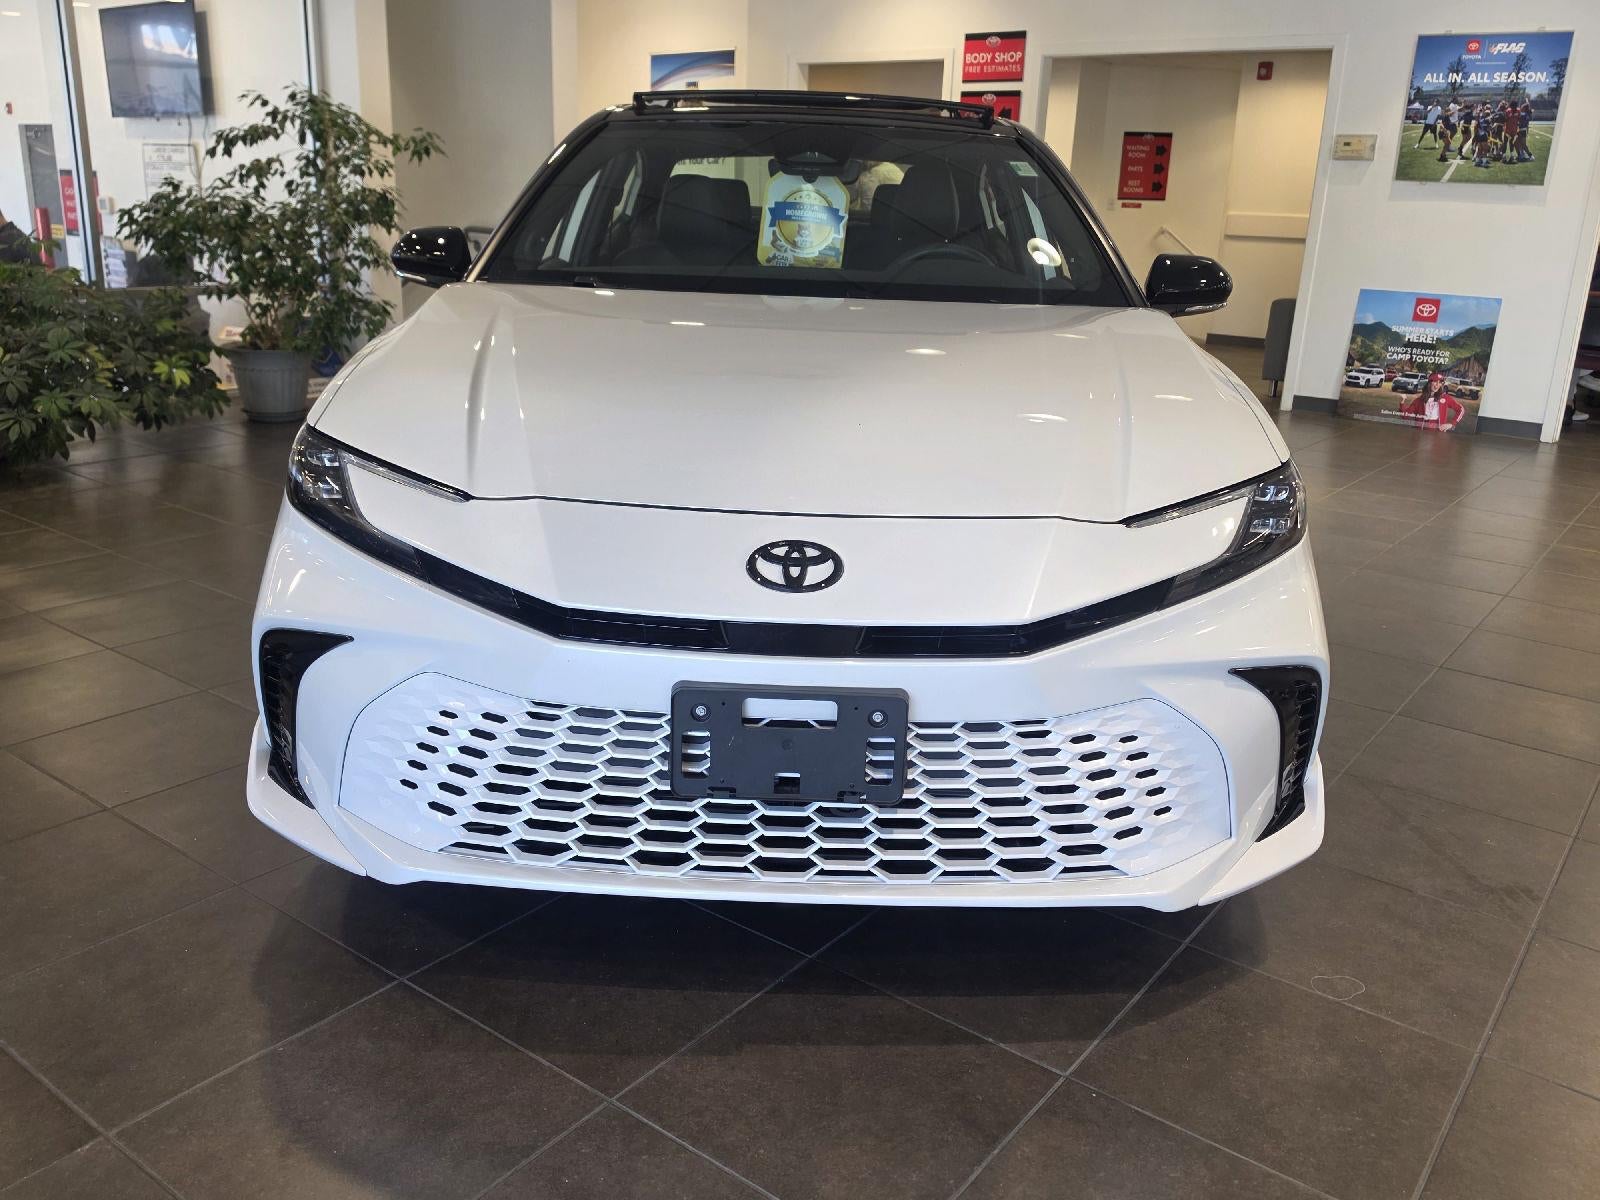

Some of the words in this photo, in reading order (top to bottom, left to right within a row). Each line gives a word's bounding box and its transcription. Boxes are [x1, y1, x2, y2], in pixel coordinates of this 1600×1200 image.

[1494, 42, 1526, 54] FLAG
[965, 52, 992, 64] BODY
[994, 52, 1022, 63] SHOP
[984, 64, 1021, 73] ESTIMATES
[1424, 72, 1445, 83] ALL
[1448, 72, 1465, 83] IN.
[1468, 72, 1491, 83] ALL
[1493, 71, 1549, 83] SEASON.
[1391, 325, 1424, 335] SUMMER
[1425, 328, 1455, 337] STARTS
[1405, 333, 1437, 344] HERE!
[1388, 345, 1411, 354] WHO'S
[1412, 348, 1435, 356] READY
[1386, 352, 1411, 361] CAMP
[1412, 355, 1449, 365] TOYOTA?
